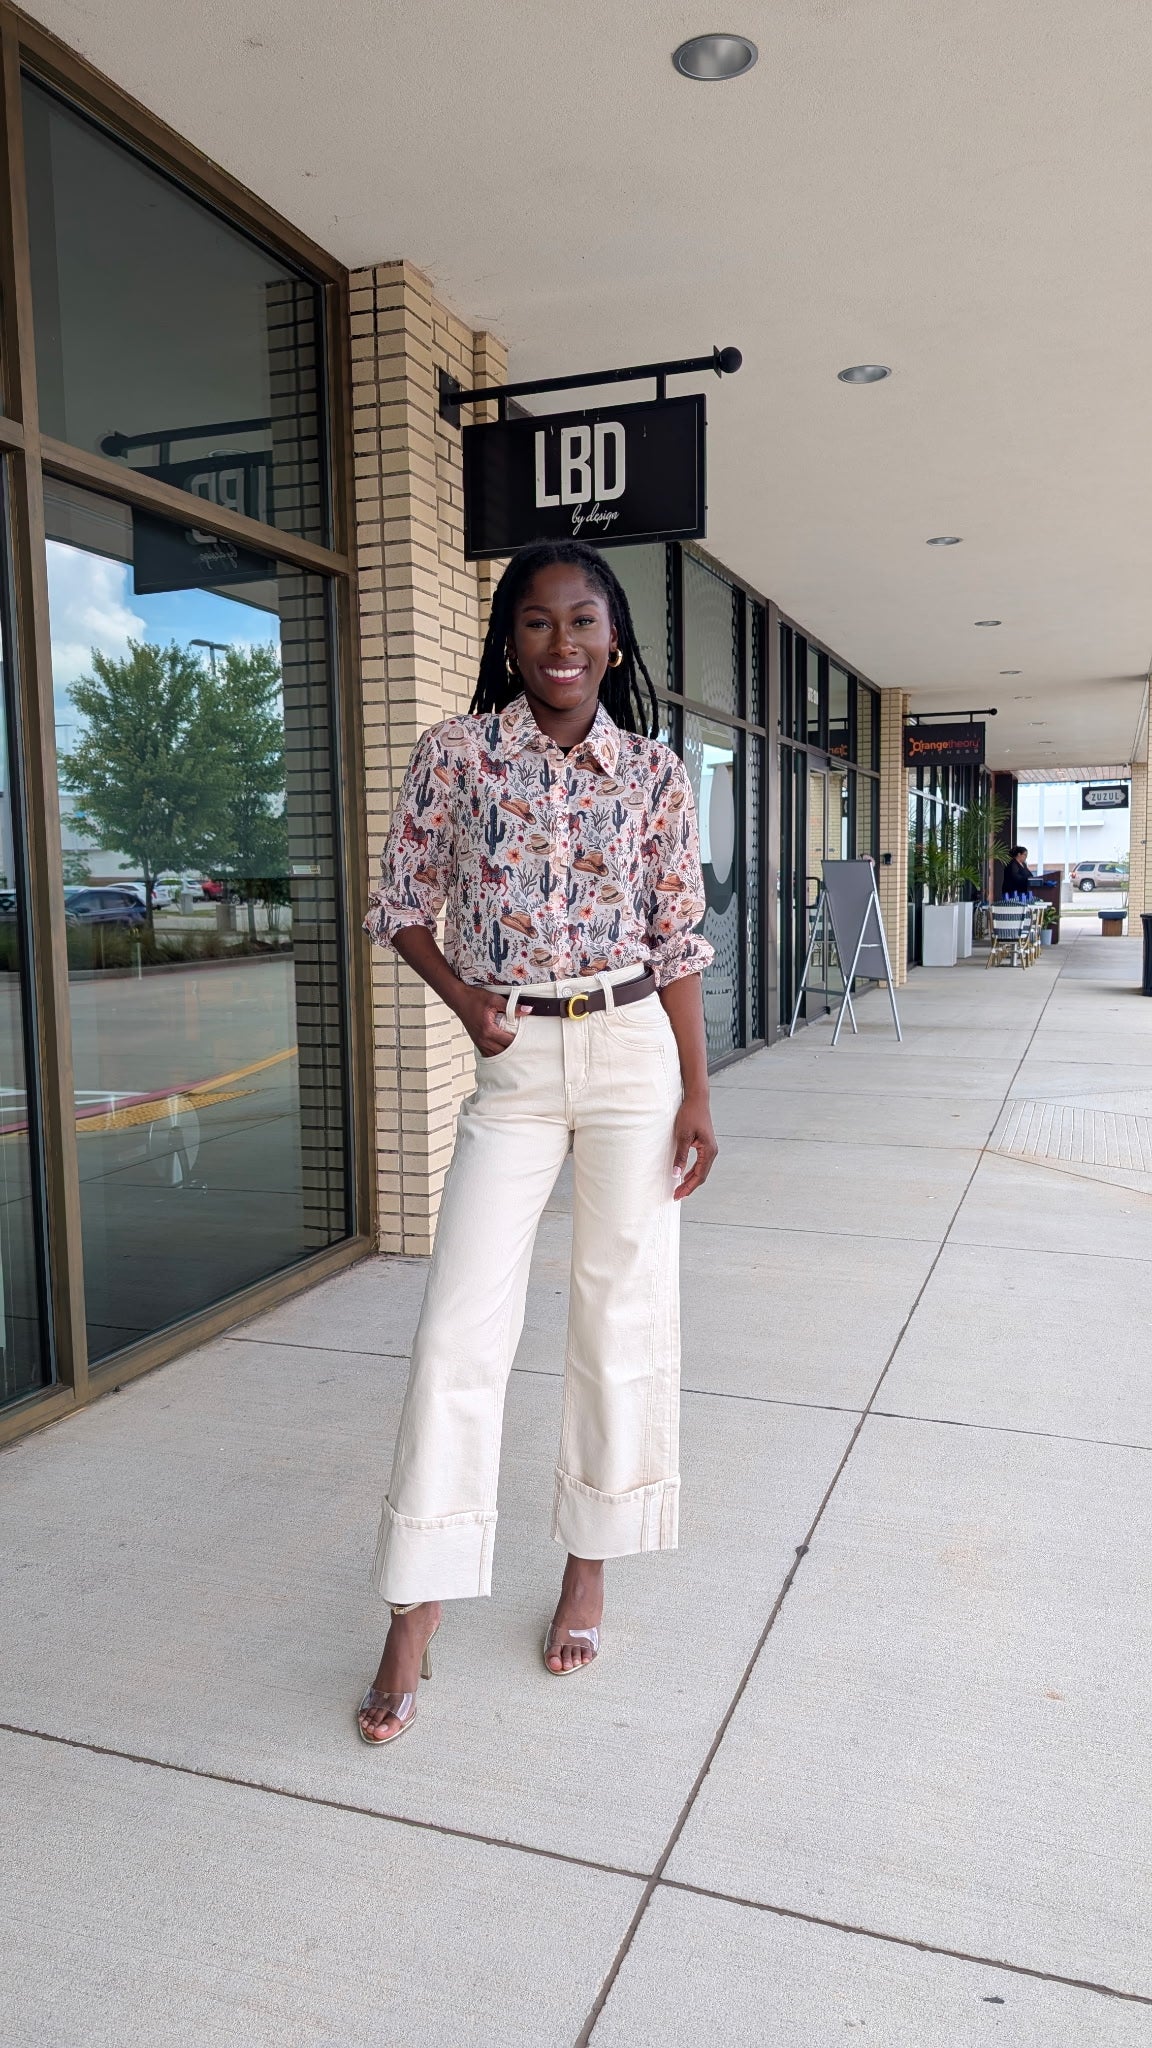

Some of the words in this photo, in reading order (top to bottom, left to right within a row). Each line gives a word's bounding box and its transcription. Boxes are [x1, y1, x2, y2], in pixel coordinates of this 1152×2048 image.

[534, 421, 626, 508] LBD
[572, 503, 585, 536] by
[586, 502, 620, 531] design
[1091, 792, 1120, 802] ZUZUL
